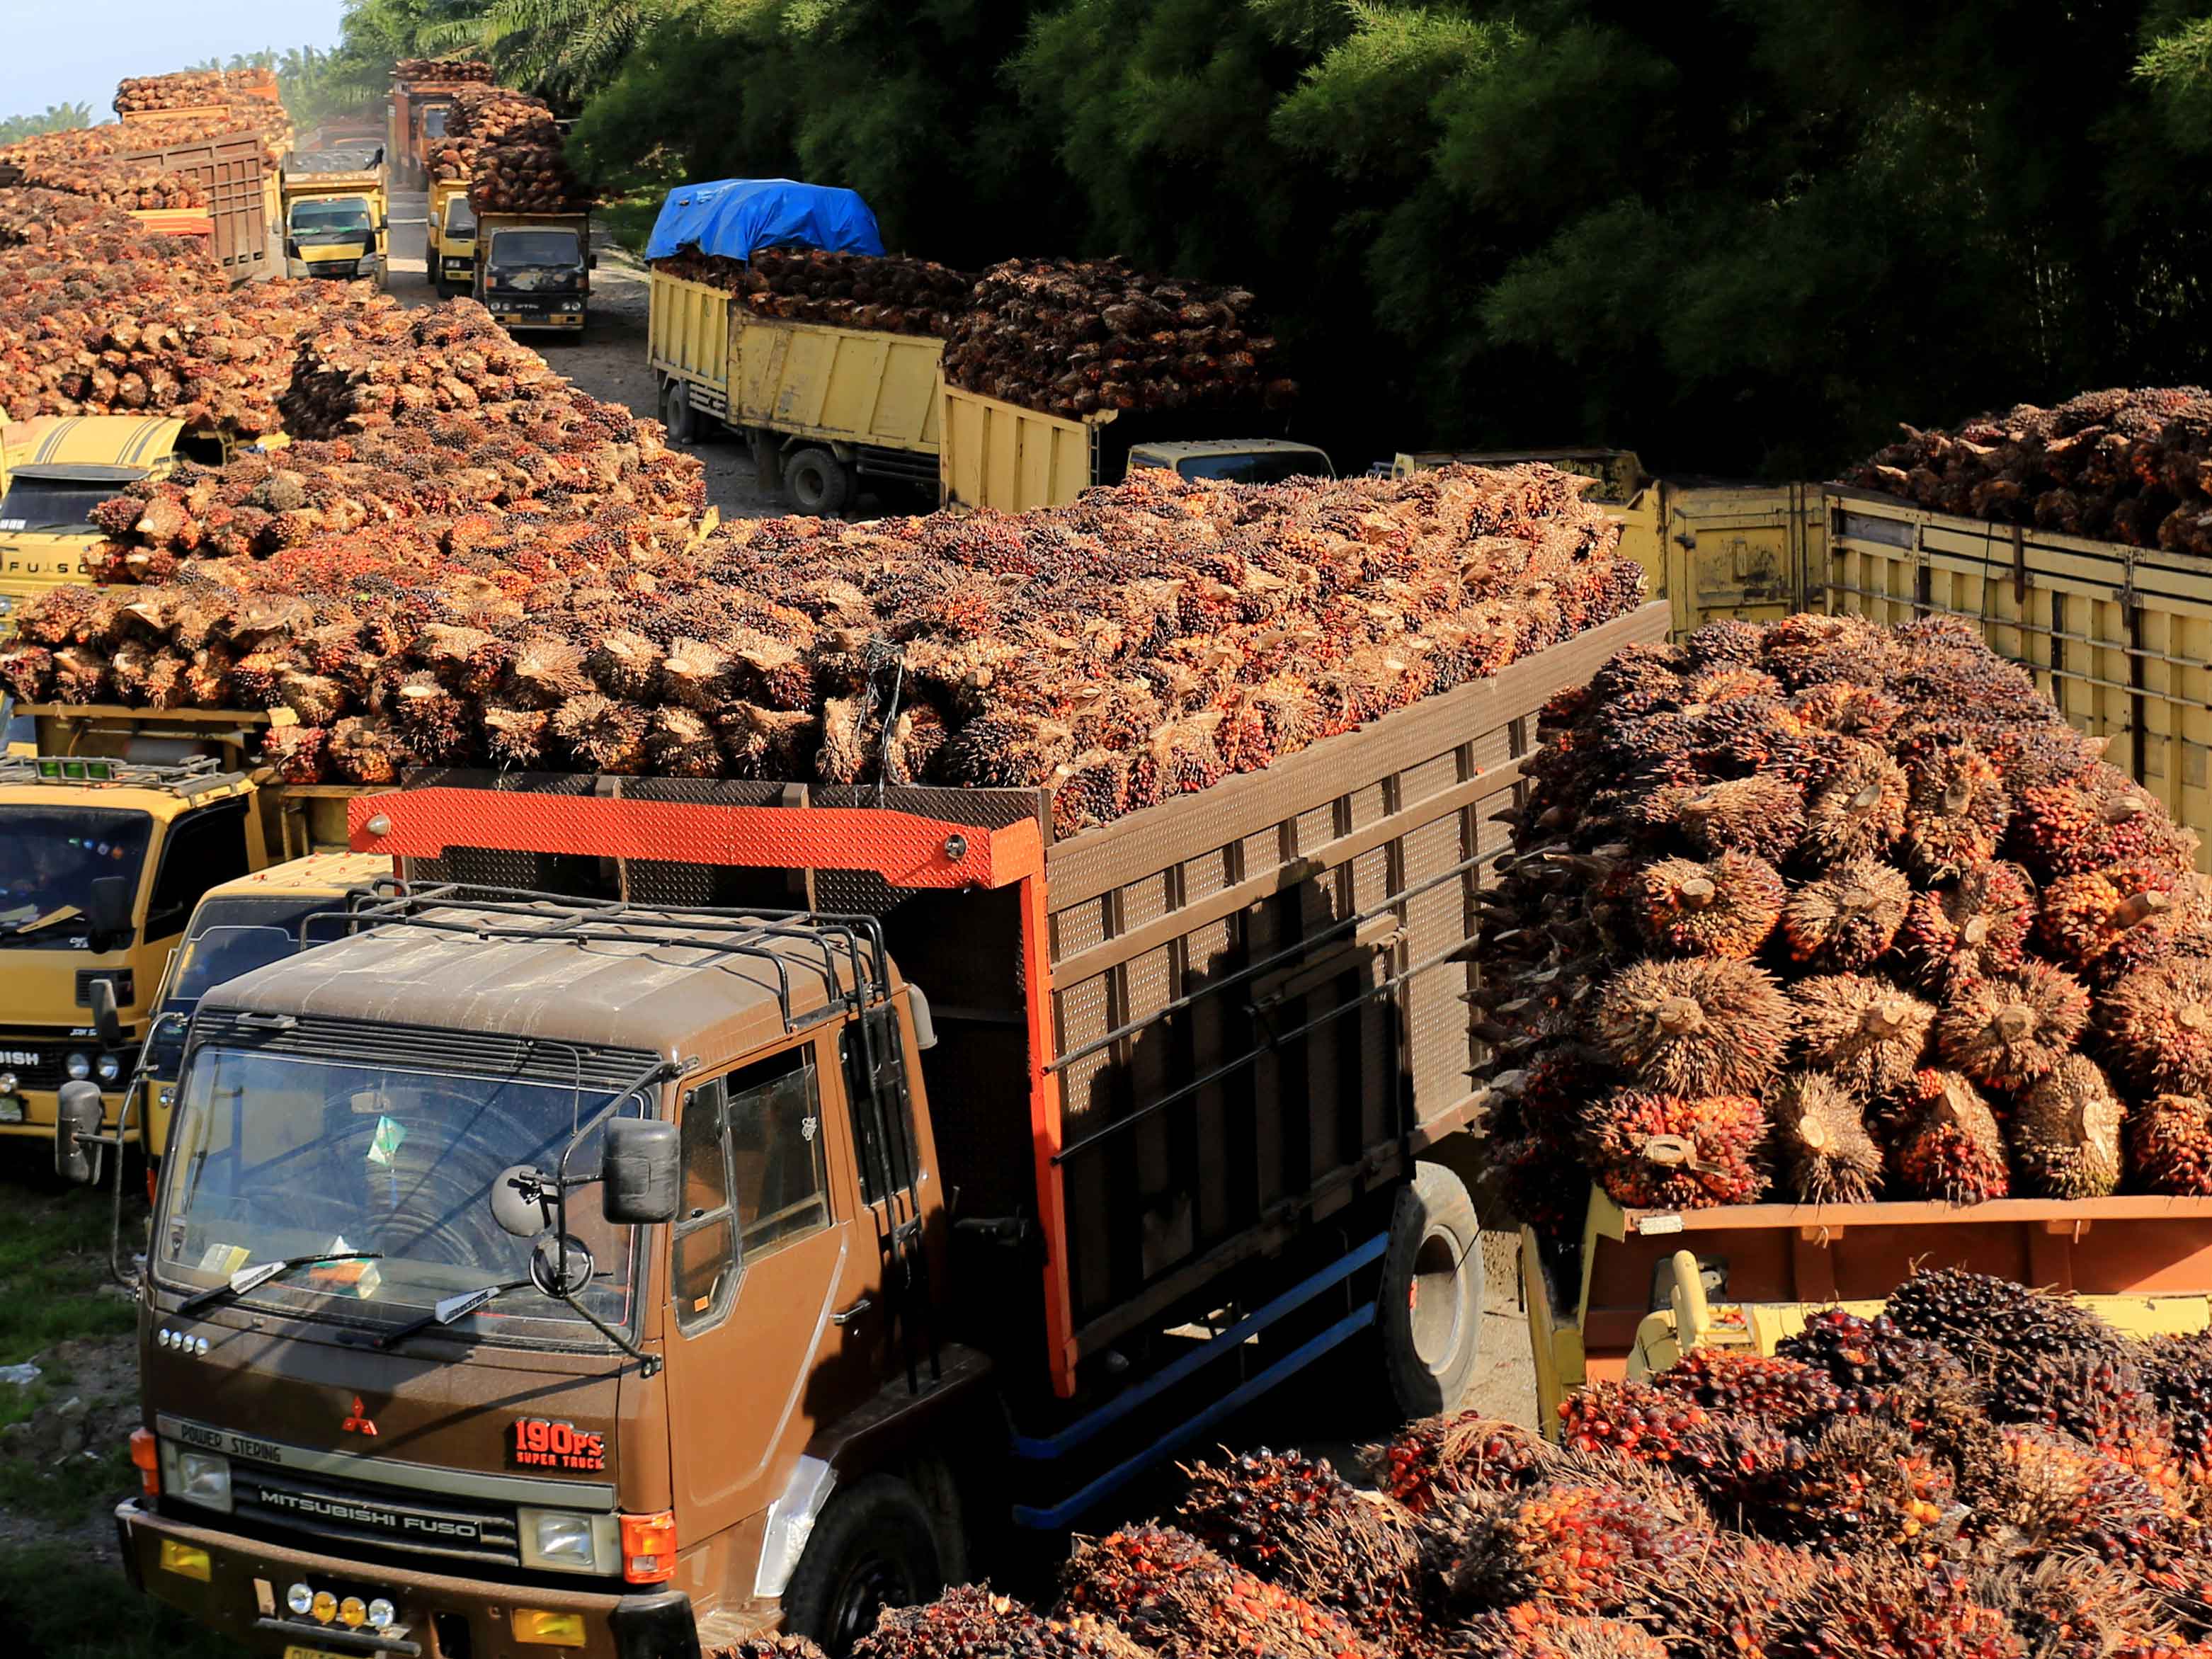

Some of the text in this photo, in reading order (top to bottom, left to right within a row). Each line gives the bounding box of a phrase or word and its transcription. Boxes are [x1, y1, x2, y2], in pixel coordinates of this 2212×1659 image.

[515, 1420, 603, 1456] 190PS
[516, 1451, 605, 1470] SUPER TRUCK
[261, 1490, 477, 1537] MITSUBISHI FUSO
